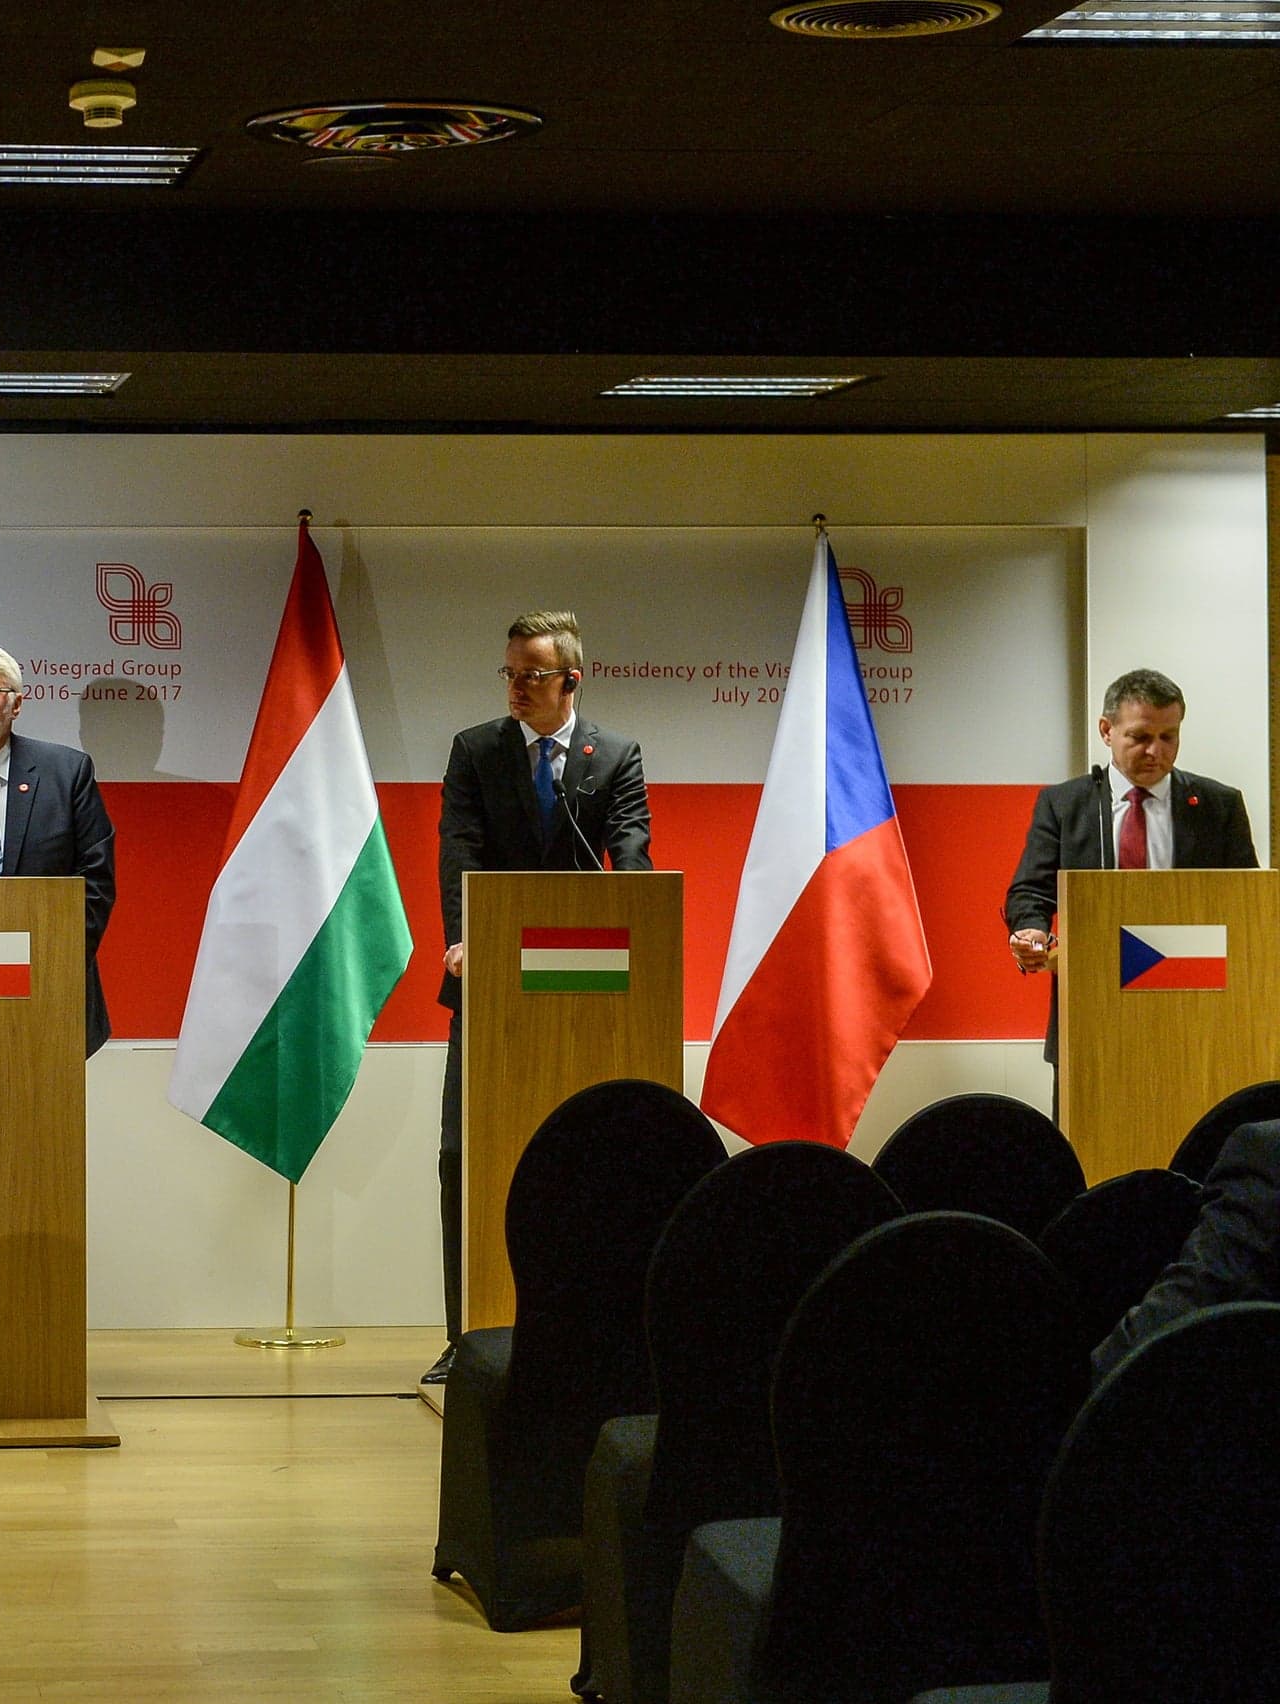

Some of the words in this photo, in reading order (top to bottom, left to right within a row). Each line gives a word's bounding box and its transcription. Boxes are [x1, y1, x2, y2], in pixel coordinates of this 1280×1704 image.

[30, 659, 114, 679] Visegrad
[122, 660, 181, 679] Group
[592, 661, 696, 682] Presidency
[703, 661, 721, 678] of
[729, 662, 759, 678] the
[22, 685, 128, 701] 2016–June
[135, 685, 182, 701] 2017
[712, 687, 749, 706] July
[867, 687, 913, 703] 2017
